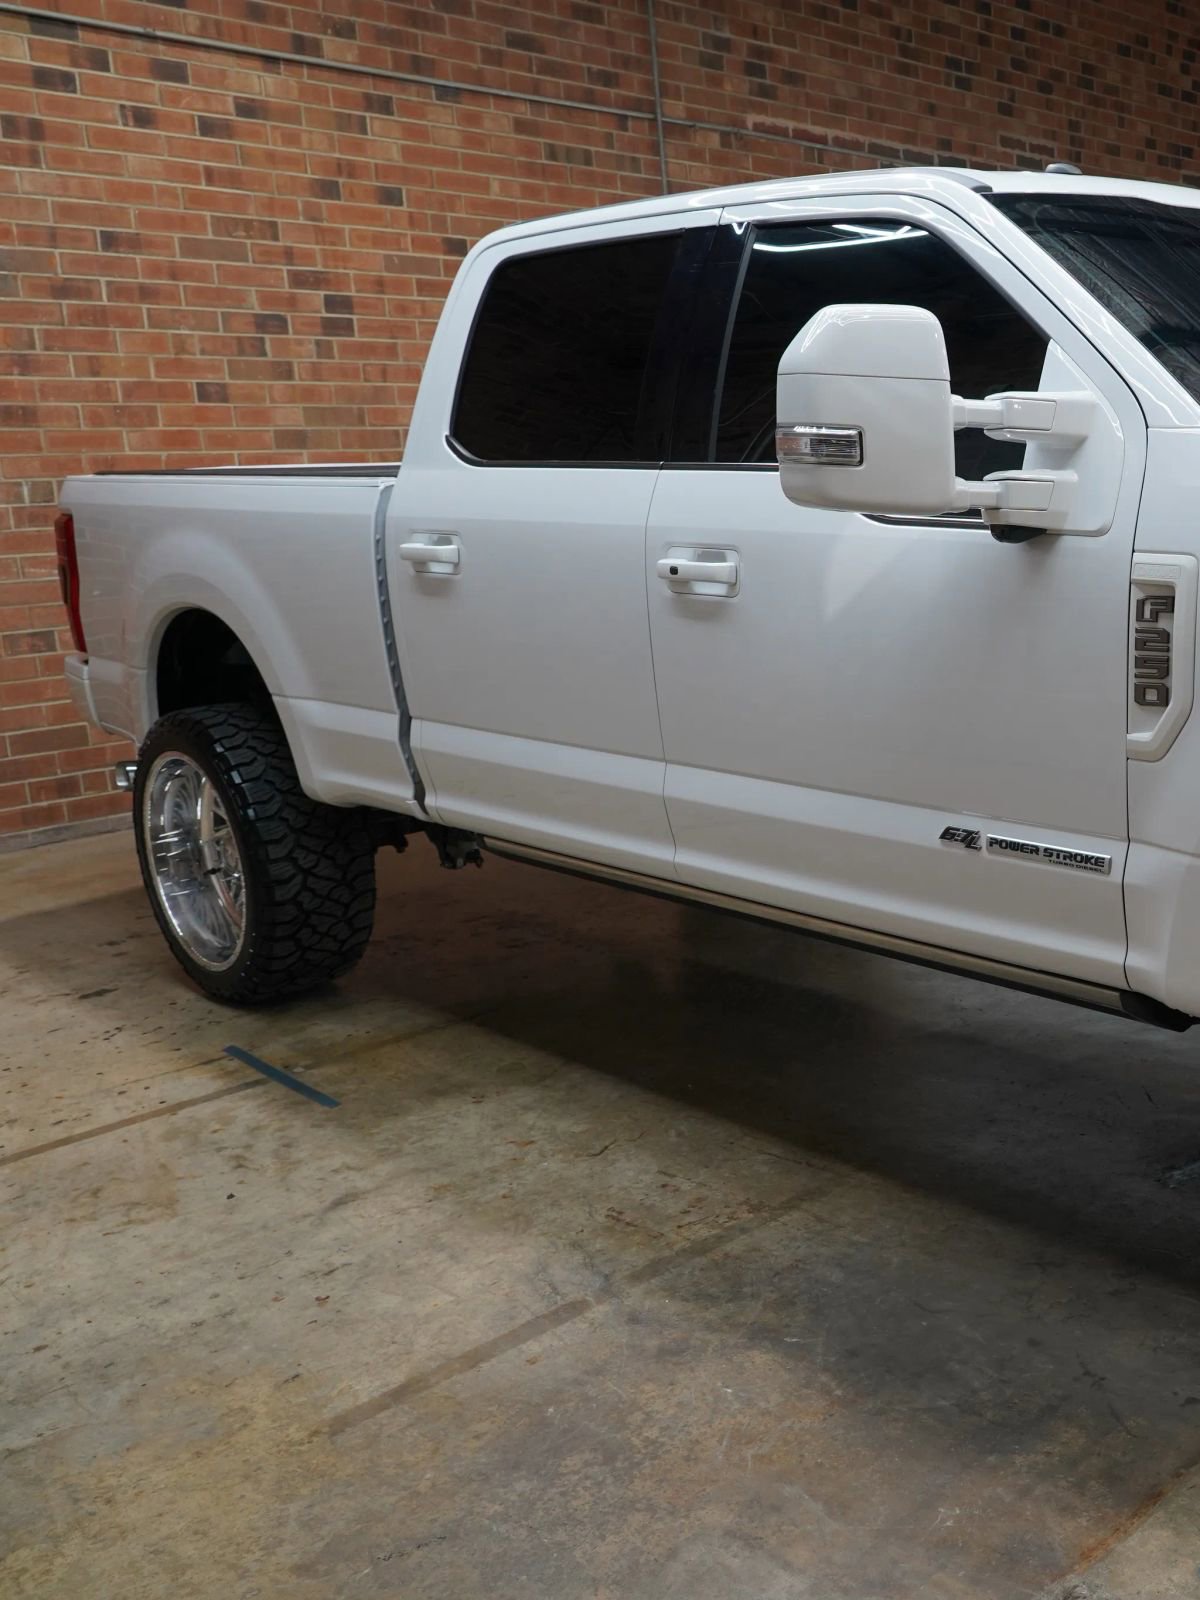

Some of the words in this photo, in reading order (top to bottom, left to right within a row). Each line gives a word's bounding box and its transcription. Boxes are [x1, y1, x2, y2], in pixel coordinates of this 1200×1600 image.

[1134, 595, 1175, 707] F250
[989, 836, 1040, 855] POWER
[1043, 847, 1105, 868] STROKE
